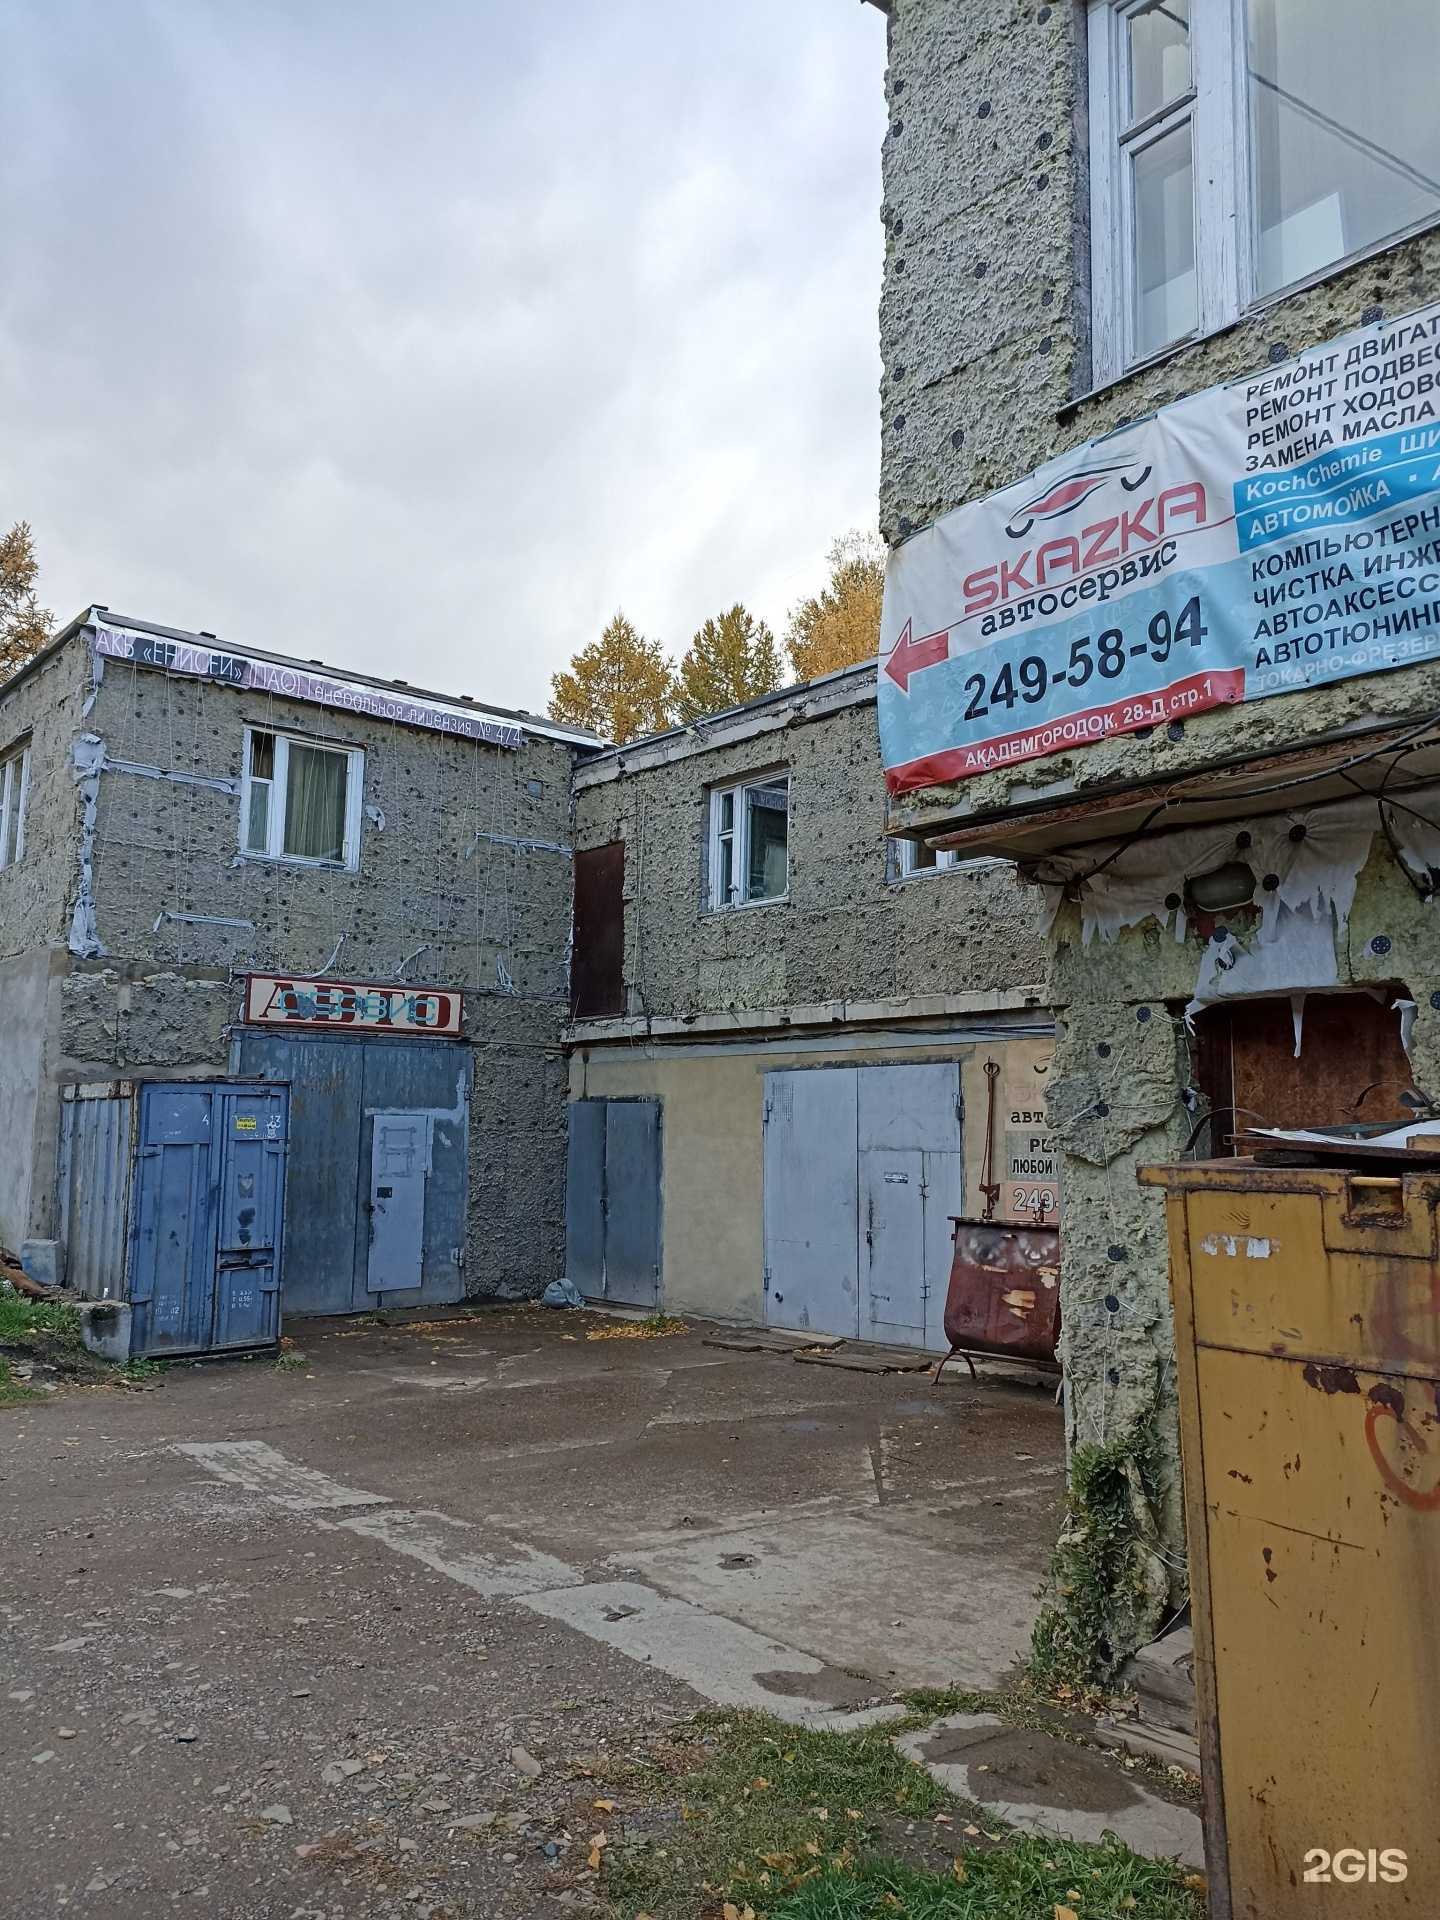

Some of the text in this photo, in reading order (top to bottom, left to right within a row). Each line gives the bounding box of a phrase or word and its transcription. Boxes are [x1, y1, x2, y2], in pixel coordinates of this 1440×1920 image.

[1246, 314, 1440, 402] РЕМОНТ ДВИГАТ
[1246, 379, 1338, 427] РЕМОНТ
[1247, 372, 1440, 450] РЕМОНТ ХОДОВ
[1245, 400, 1436, 472] ЗАМЕНА МАСЛА
[1246, 447, 1383, 501] KochChemie
[1250, 479, 1392, 539] АВТОМОЙКА
[962, 481, 1207, 614] SKAZKA
[1252, 505, 1440, 582] КОМПЬЮТЕРН
[979, 540, 1178, 637] автосервис
[1253, 562, 1355, 609] ЧИСТКА
[1253, 573, 1440, 640] АВТОАКСЕСС
[963, 595, 1209, 721] 249-58-94
[1255, 634, 1438, 692] ТОКАРНО-ФРЕЗЕР
[965, 712, 1118, 768] АКАДЕМГОРОДОК,
[258, 982, 451, 1030] АВТО
[1010, 1111, 1048, 1124] авт
[1012, 1158, 1053, 1174] ЛЮБОЙ
